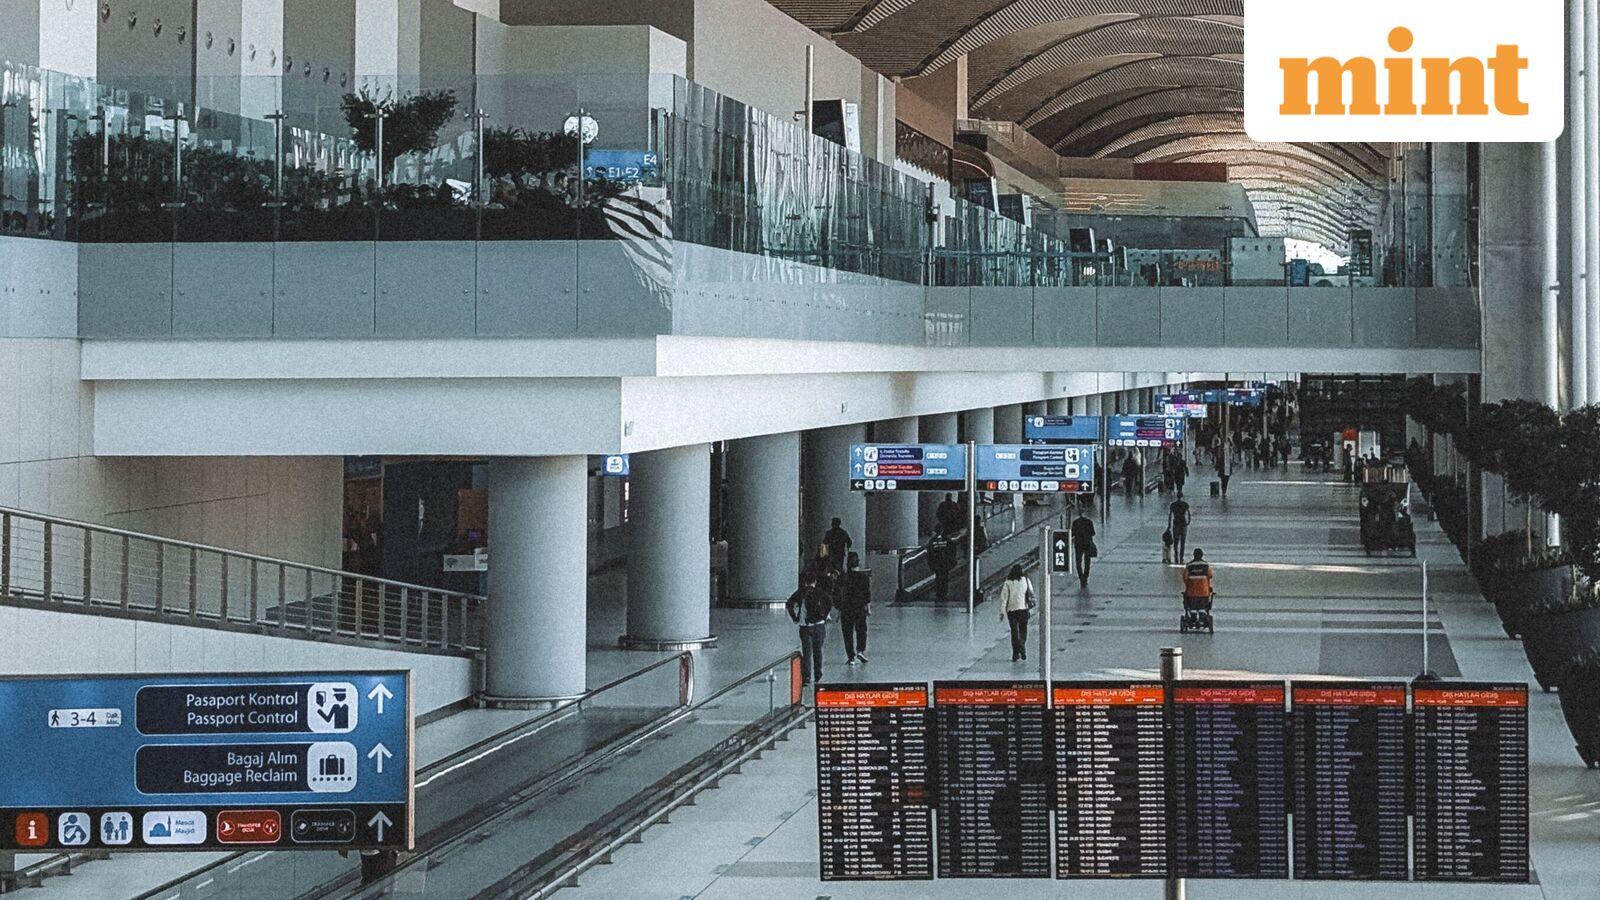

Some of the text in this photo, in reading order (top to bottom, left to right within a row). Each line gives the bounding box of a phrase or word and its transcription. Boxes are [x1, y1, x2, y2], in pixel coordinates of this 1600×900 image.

[186, 691, 298, 709] Pasaport Kontrol
[70, 711, 97, 727] 3-4
[187, 710, 298, 728] Passport Control
[227, 751, 298, 768] Bagaj Alım
[183, 768, 298, 785] Baggage Reclaim
